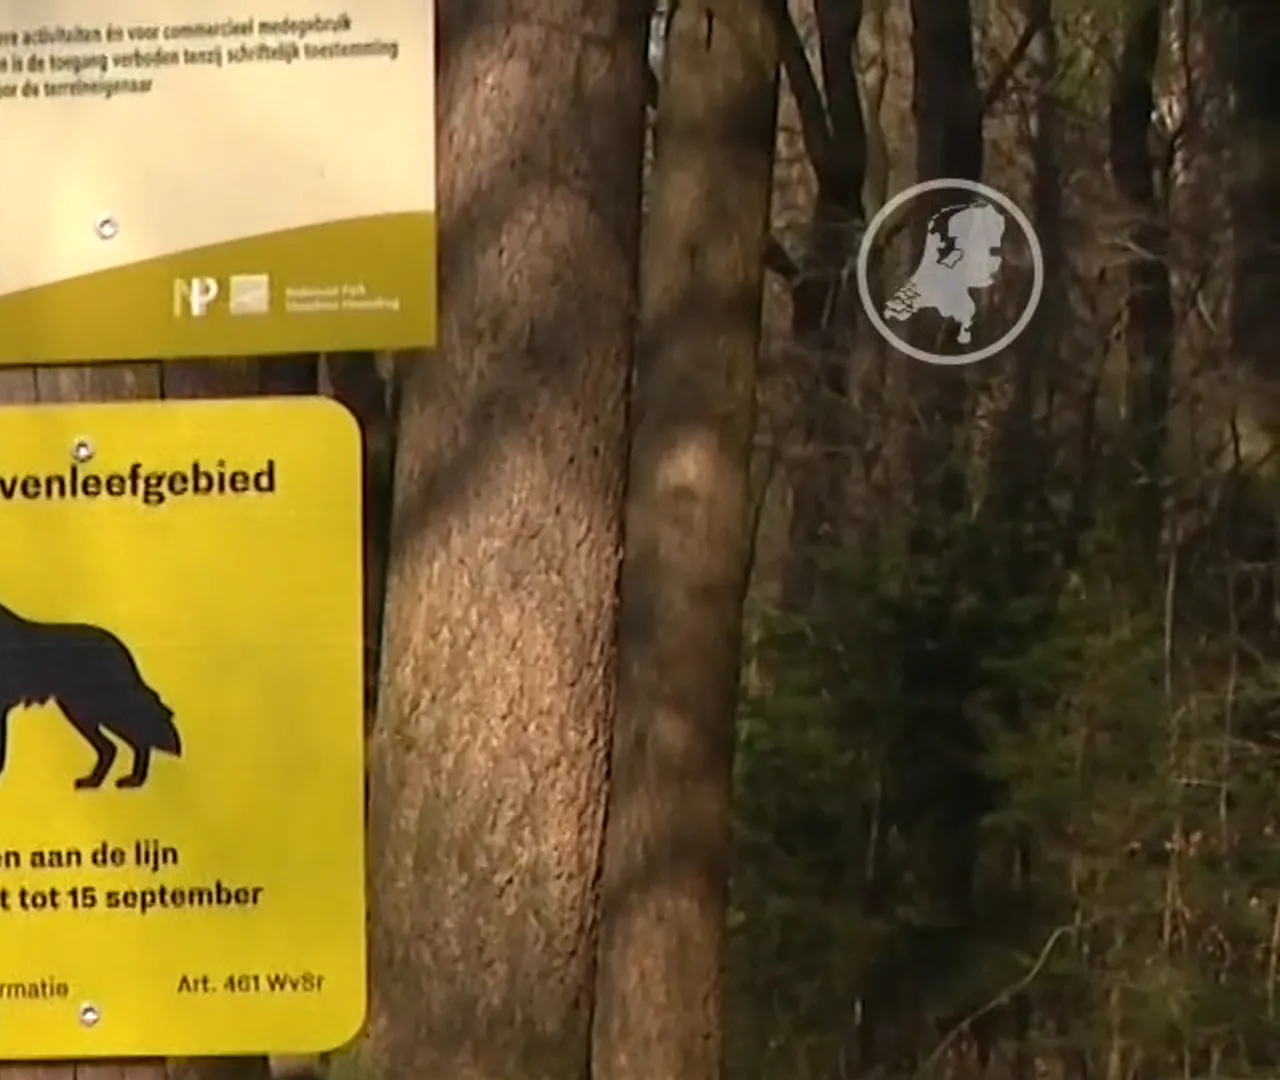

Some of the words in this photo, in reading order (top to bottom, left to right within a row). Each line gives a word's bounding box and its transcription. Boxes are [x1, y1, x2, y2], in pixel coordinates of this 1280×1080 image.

[128, 26, 159, 40] voor
[258, 13, 351, 38] medegebruik
[11, 54, 23, 73] is
[27, 53, 44, 72] de
[49, 54, 108, 74] toegang
[112, 48, 180, 68] verboden
[184, 45, 222, 68] tenzij
[227, 41, 299, 64] schriftelijk
[303, 39, 399, 60] toestemming
[22, 79, 40, 98] de
[44, 78, 153, 99] terreineigenaar
[29, 847, 82, 869] aan
[91, 841, 126, 868] de
[135, 839, 179, 873] lijn
[19, 886, 60, 912] tot
[69, 885, 98, 910] 15
[105, 880, 264, 914] september
[177, 974, 217, 995] Art.
